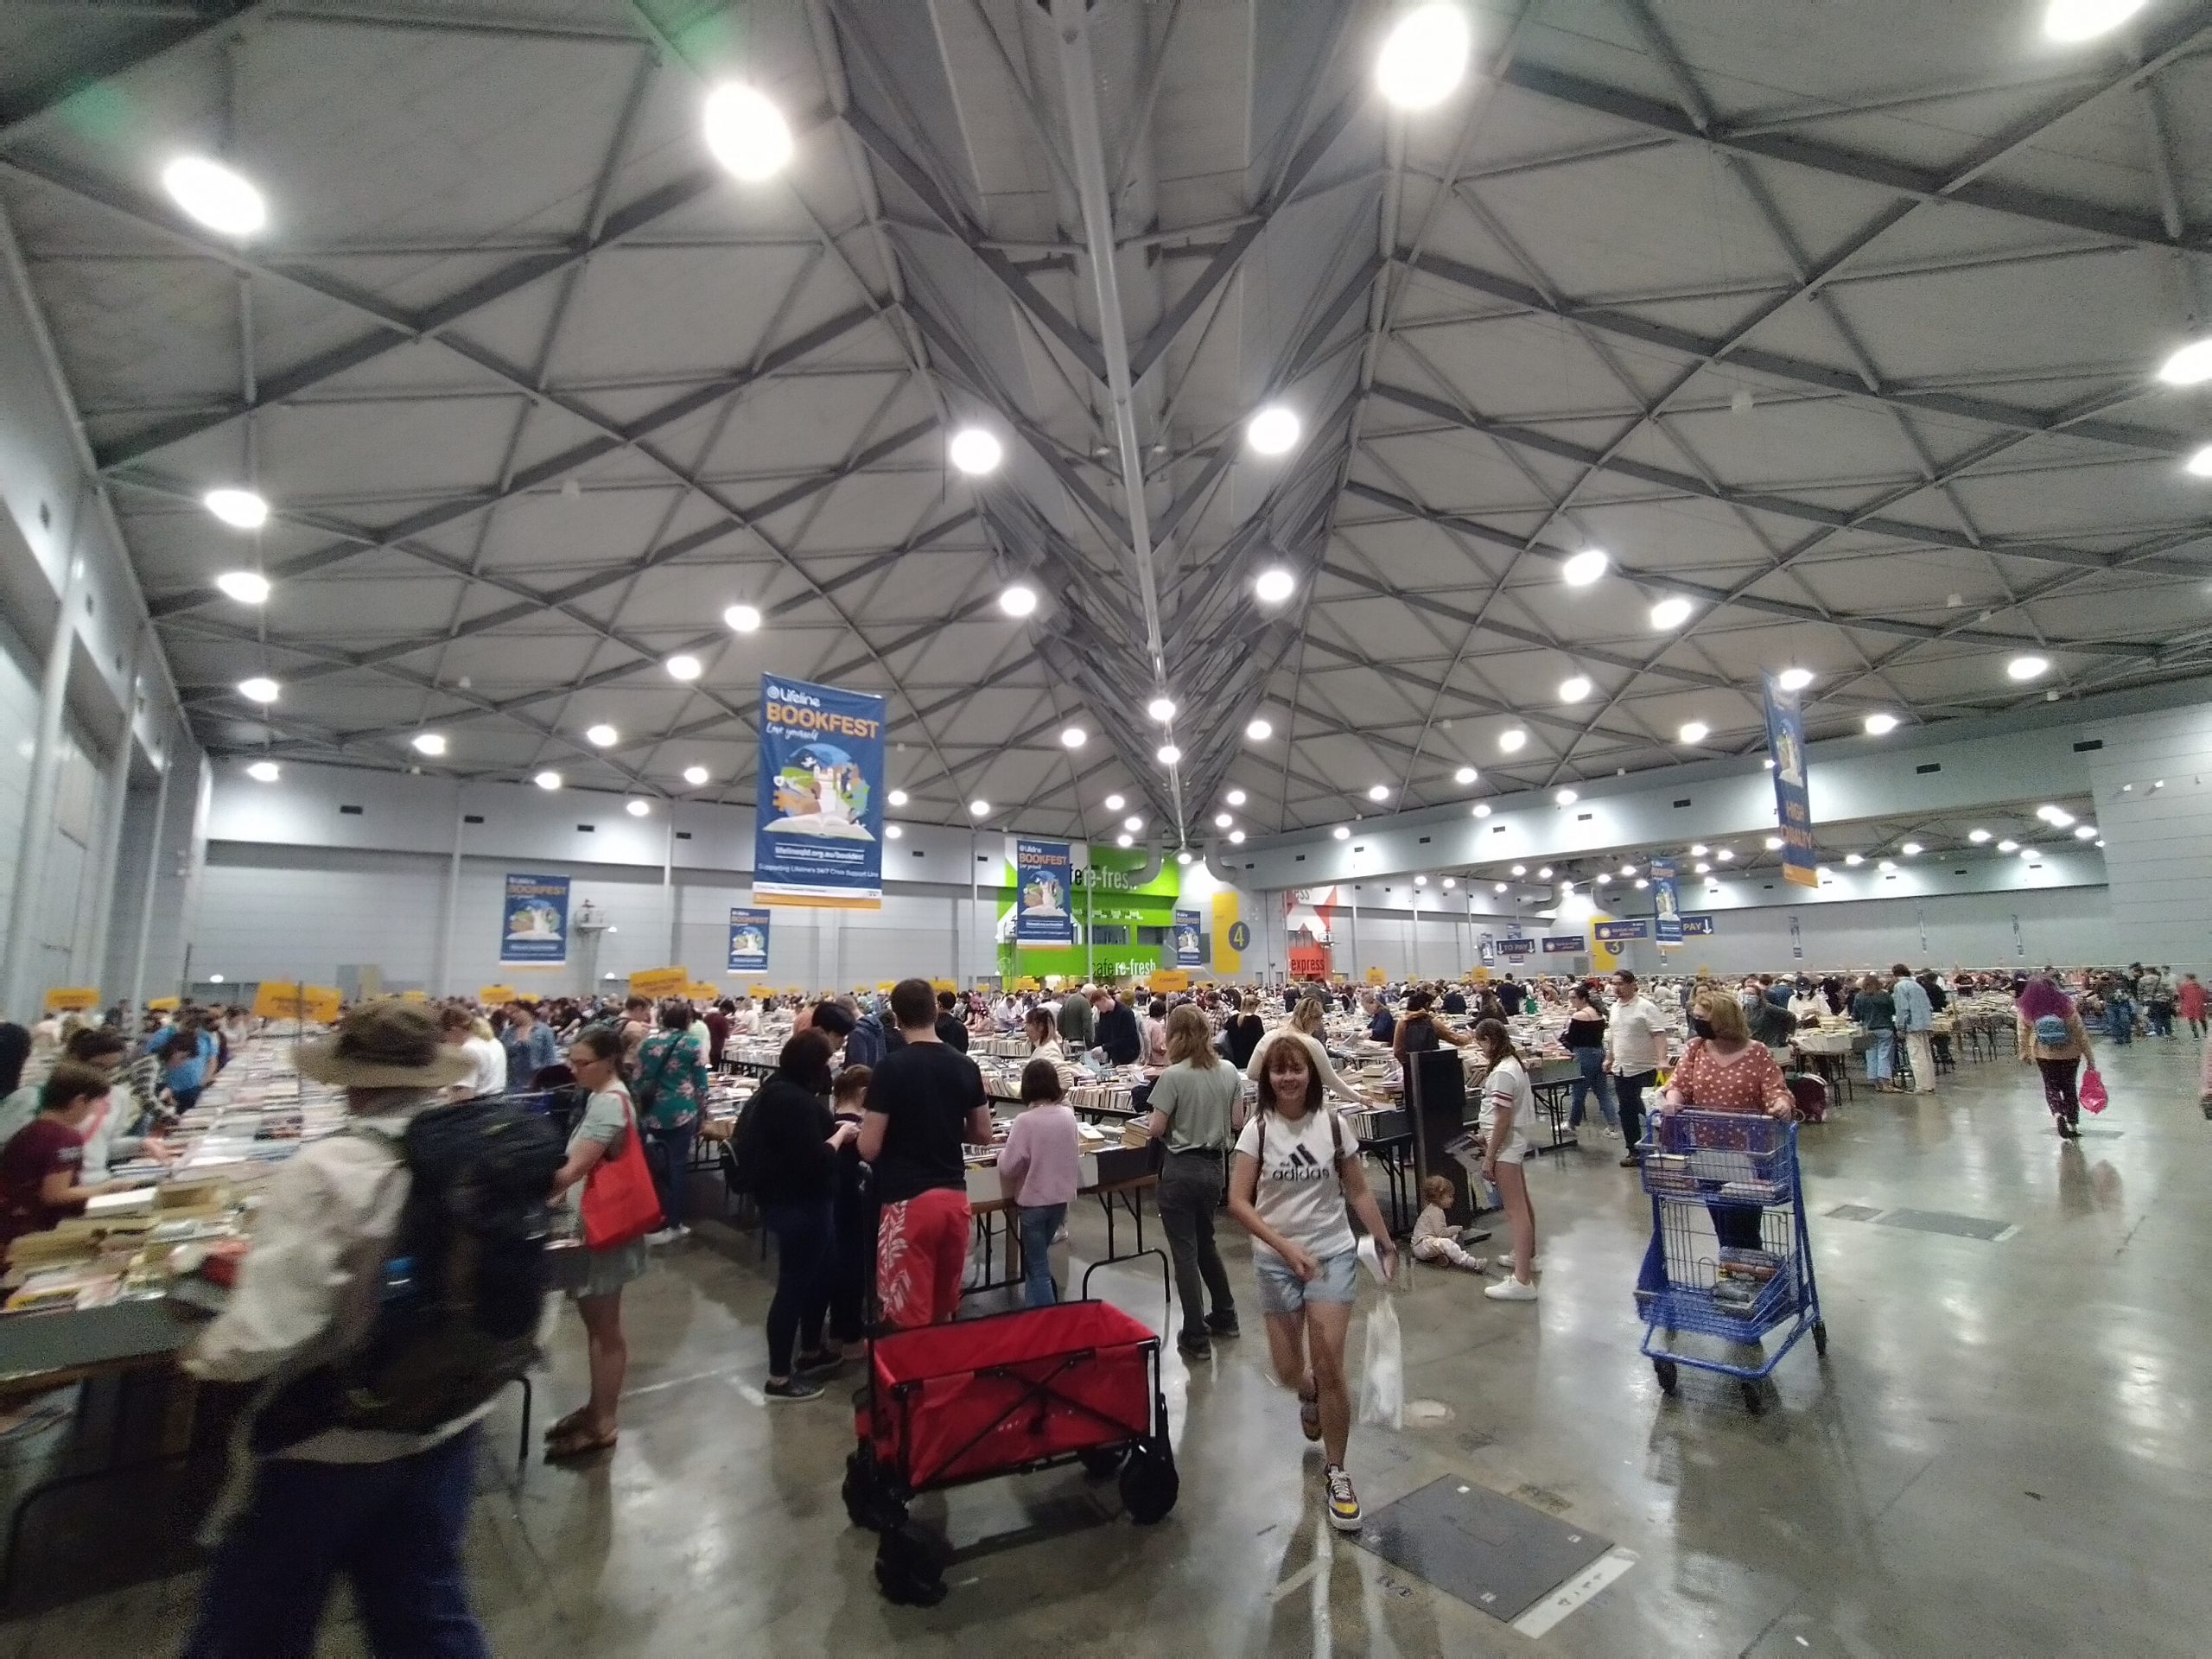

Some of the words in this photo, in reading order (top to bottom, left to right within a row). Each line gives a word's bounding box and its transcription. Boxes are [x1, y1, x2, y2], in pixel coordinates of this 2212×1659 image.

[780, 688, 821, 708] Lifeline
[766, 702, 880, 739] BOOKFEST
[1019, 853, 1067, 866] BOOKFEST
[1682, 922, 1701, 931] PAY
[1233, 925, 1244, 947] 4
[1115, 958, 1156, 976] re-fresh
[1291, 958, 1325, 975] express
